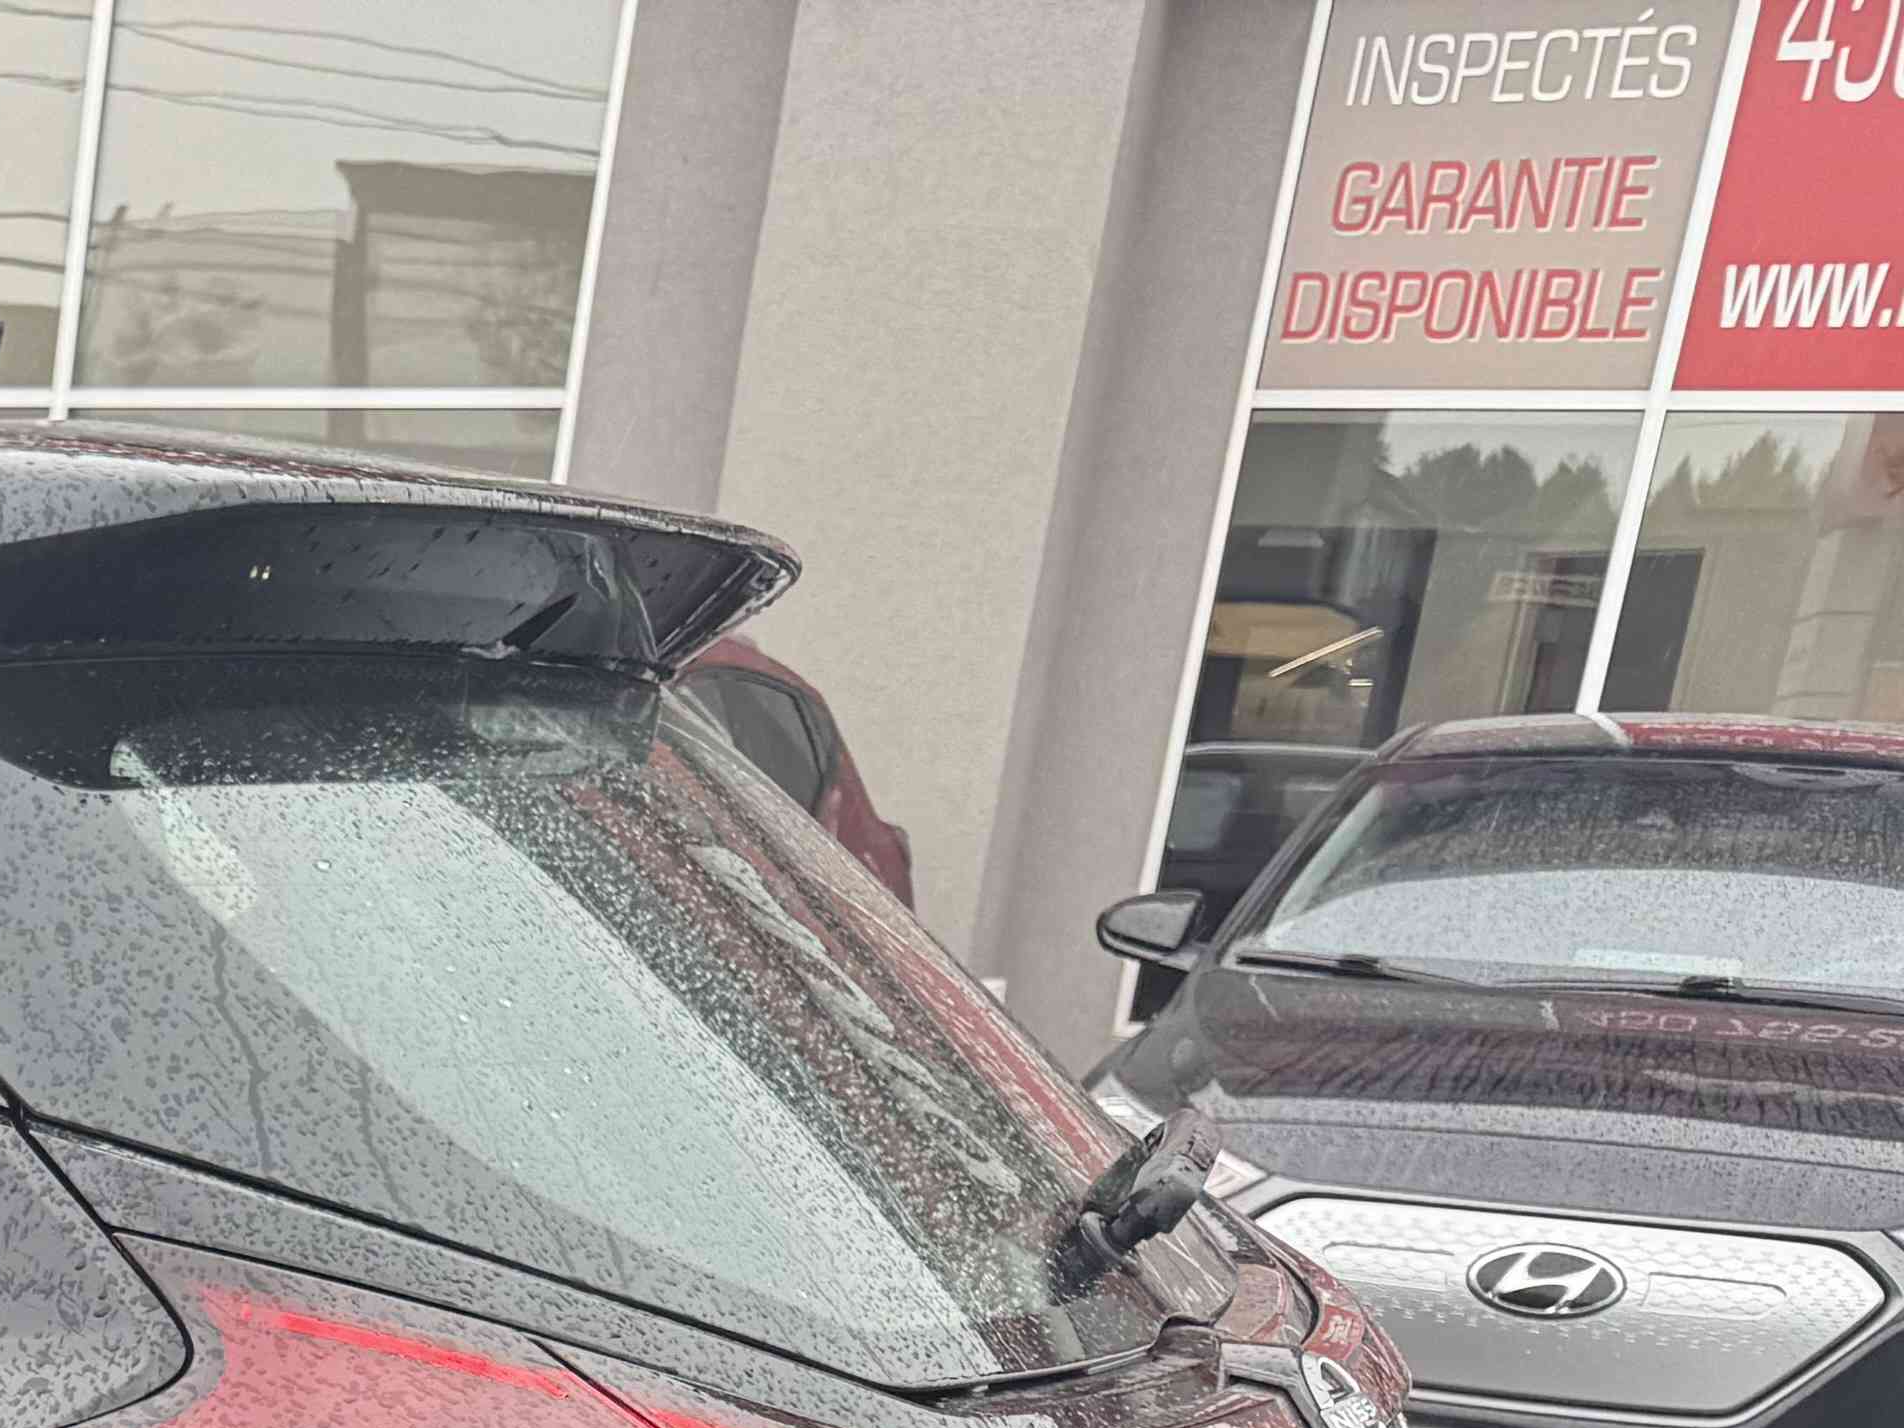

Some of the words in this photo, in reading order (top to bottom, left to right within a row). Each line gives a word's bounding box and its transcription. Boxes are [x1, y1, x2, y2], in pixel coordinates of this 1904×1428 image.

[1345, 8, 1698, 106] INSPECTÉS
[1330, 155, 1662, 235] GARANTIE
[1281, 268, 1664, 343] DISPONIBLE
